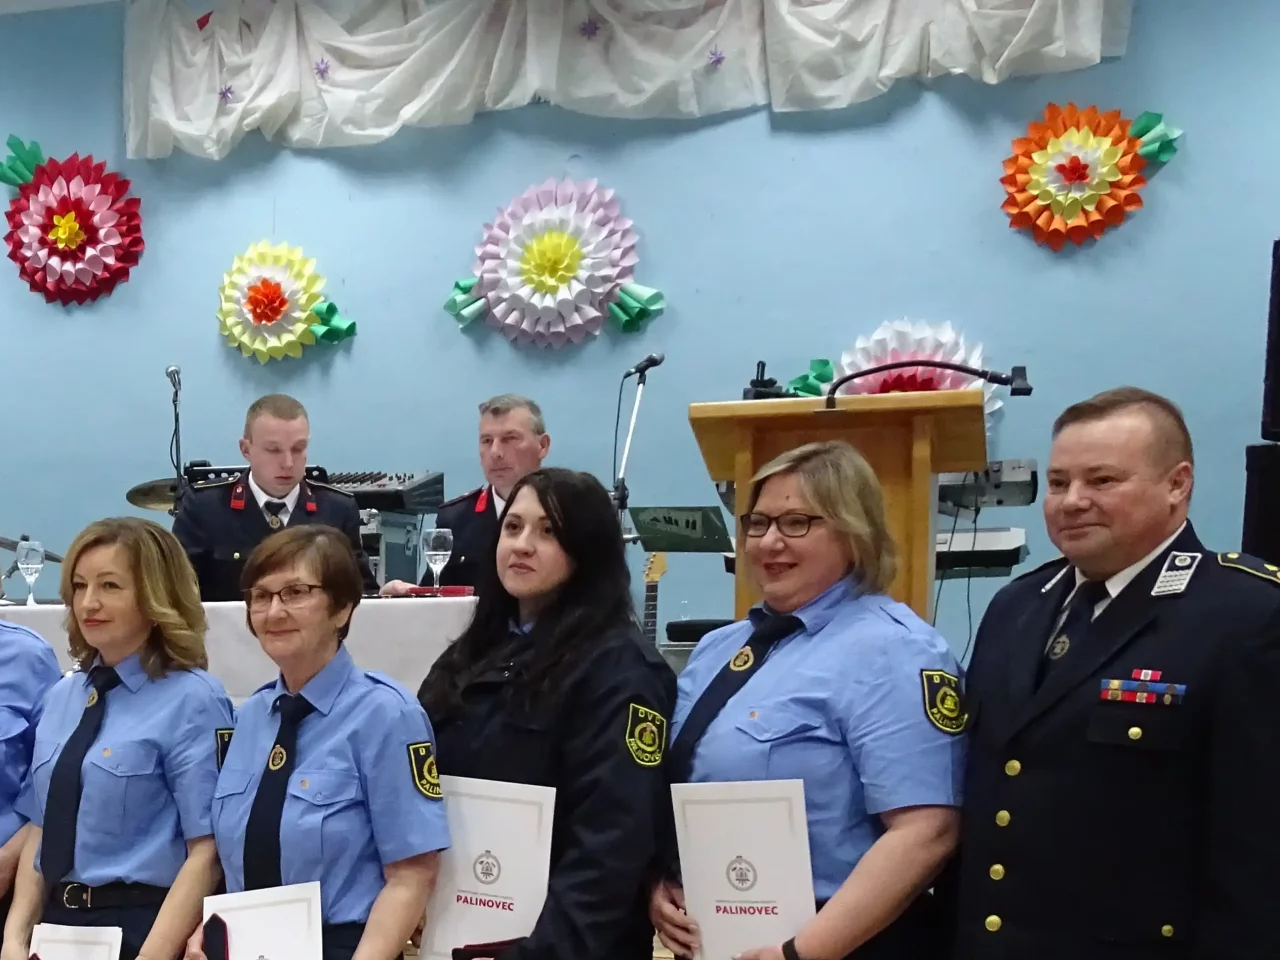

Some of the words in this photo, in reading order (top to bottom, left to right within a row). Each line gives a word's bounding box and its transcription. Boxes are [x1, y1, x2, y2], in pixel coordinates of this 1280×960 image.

[419, 778, 443, 794] PALIN
[456, 894, 515, 912] PALINOVEC
[715, 904, 779, 916] PALINOVEC
